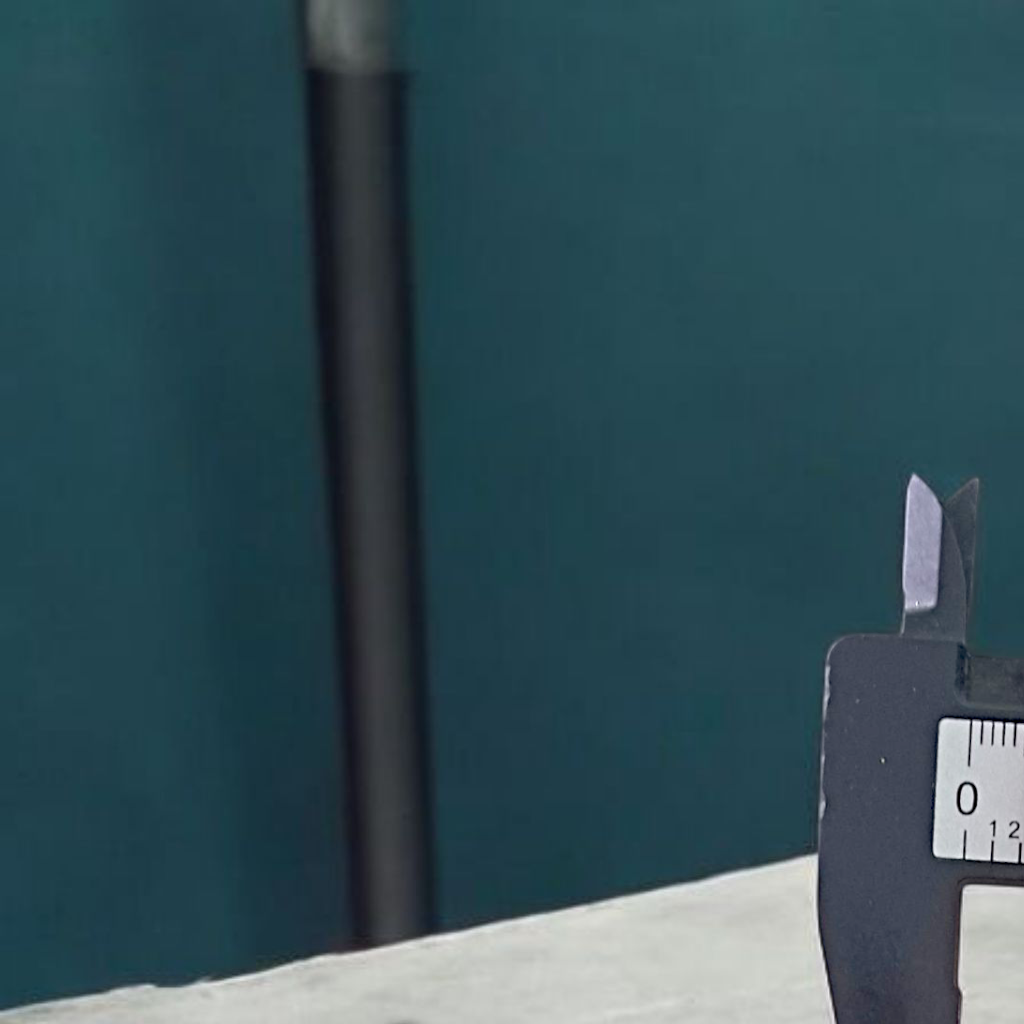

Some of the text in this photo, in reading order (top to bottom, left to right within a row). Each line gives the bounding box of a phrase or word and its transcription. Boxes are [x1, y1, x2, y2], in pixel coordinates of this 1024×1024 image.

[956, 781, 978, 816] 0
[989, 820, 1021, 839] 1 2
